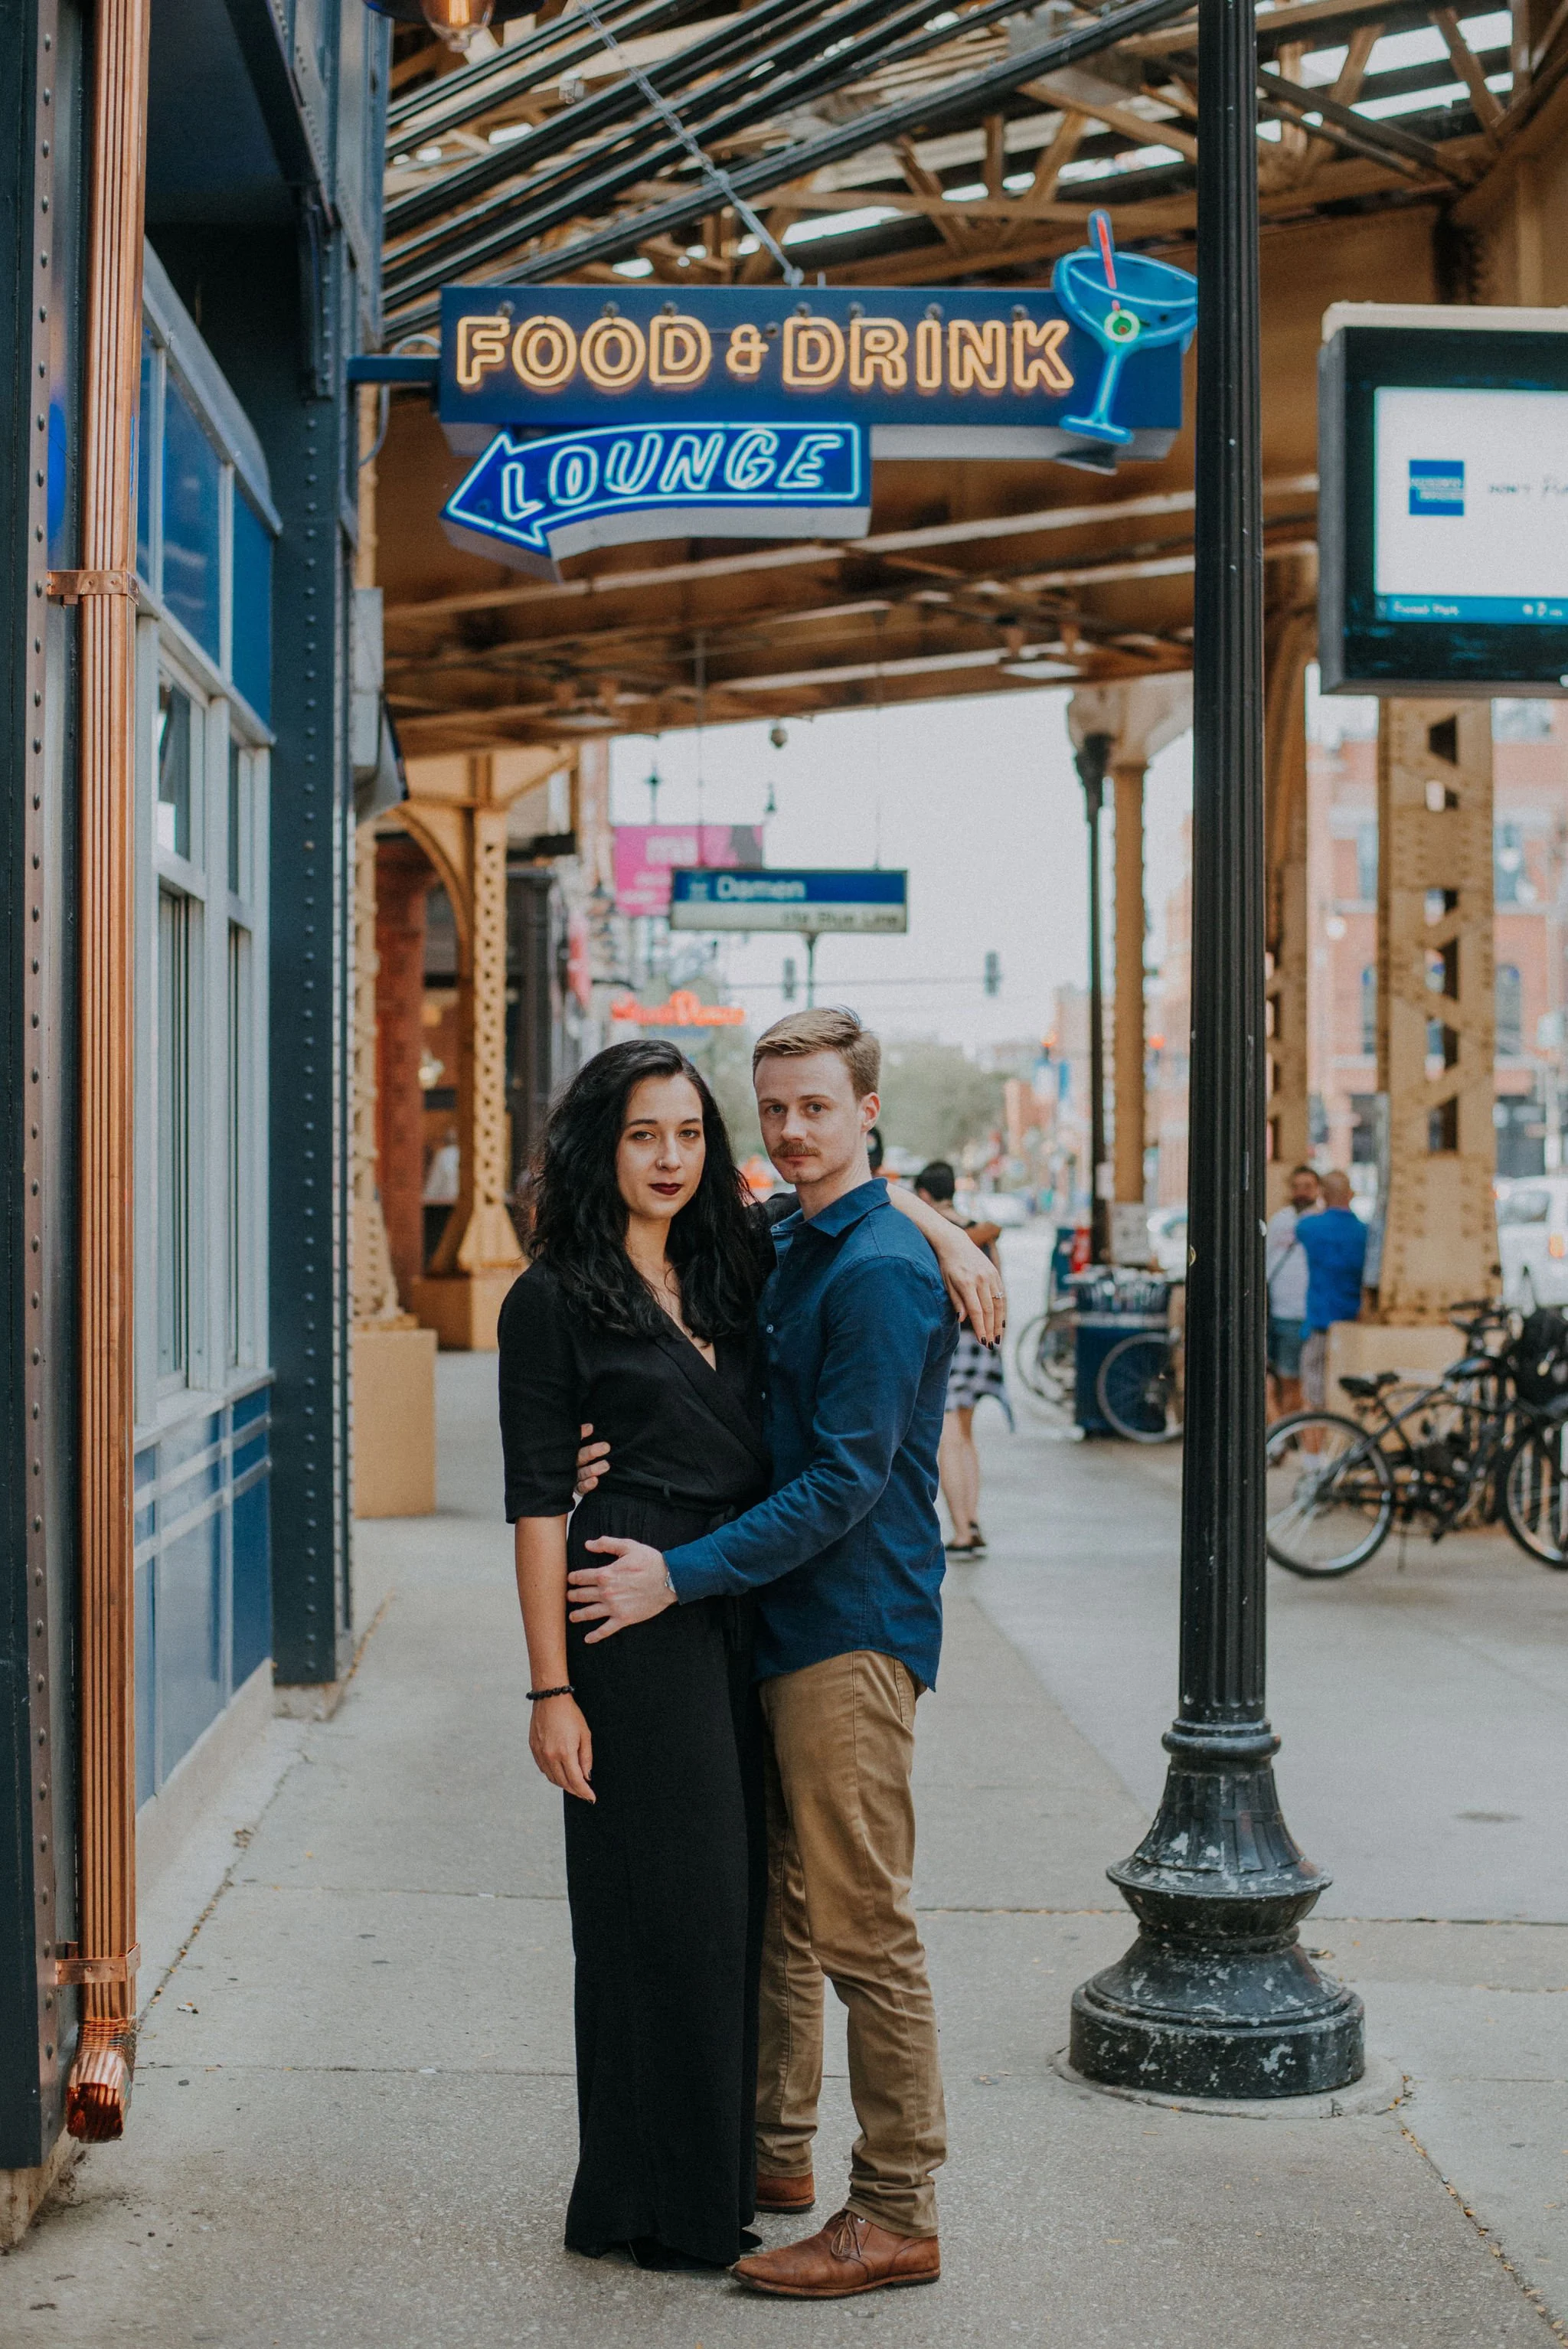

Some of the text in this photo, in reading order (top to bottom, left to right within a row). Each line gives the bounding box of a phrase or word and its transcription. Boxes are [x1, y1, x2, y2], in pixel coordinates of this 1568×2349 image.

[456, 315, 1074, 389] FOOD & DRINK
[501, 428, 843, 521] LOUNGE
